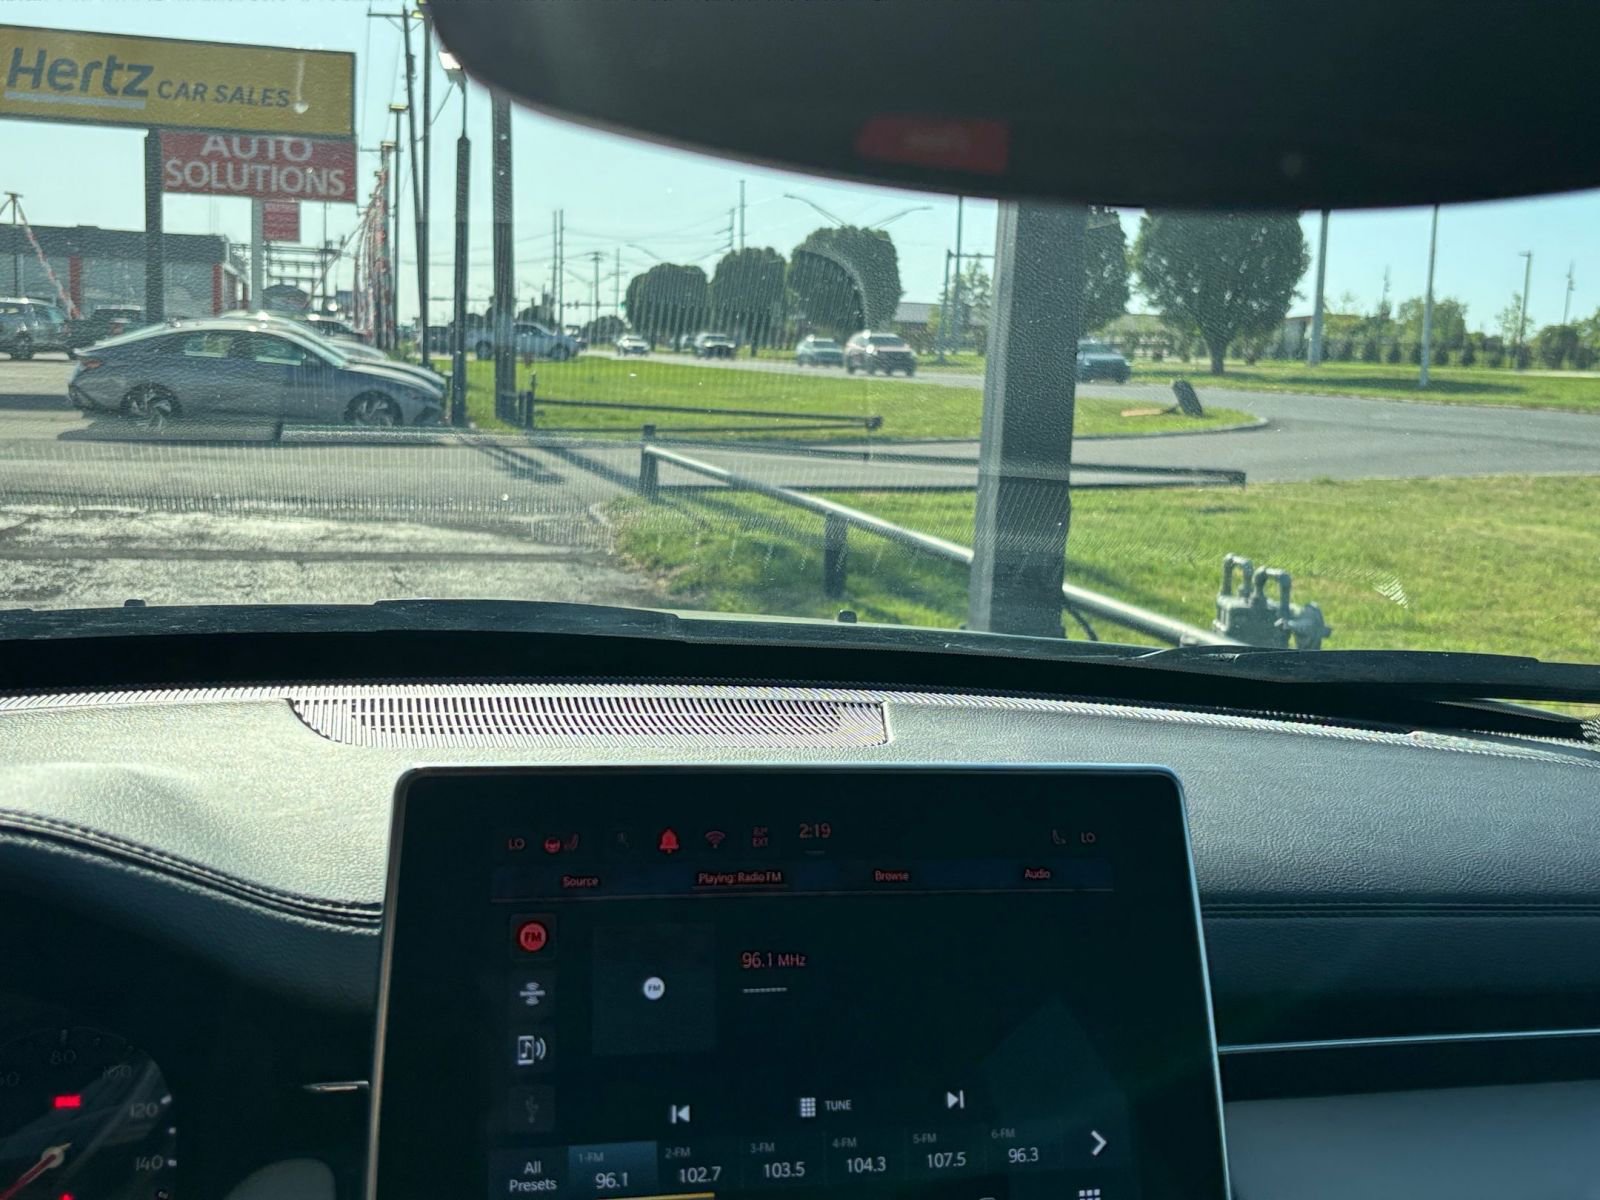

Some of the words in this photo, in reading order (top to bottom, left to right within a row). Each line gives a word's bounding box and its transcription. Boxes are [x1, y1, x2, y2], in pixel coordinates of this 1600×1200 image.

[6, 47, 154, 97] Hertz
[157, 80, 208, 101] CAR
[215, 84, 291, 108] SALES
[200, 135, 313, 161] AUTO
[164, 158, 346, 196] SOLUTIONS
[799, 823, 831, 839] 2:19
[1080, 832, 1096, 844] LO
[508, 838, 525, 850] LO
[874, 870, 910, 882] Browse
[1024, 868, 1051, 880] Audio
[562, 876, 599, 888] Source
[523, 931, 542, 944] FM
[741, 952, 773, 968] 96.1
[778, 954, 807, 968] MHz
[130, 1102, 158, 1118] 120
[825, 1099, 852, 1112] TUNE
[913, 1132, 937, 1144] 5-FM
[991, 1127, 1016, 1140] 6-FM
[750, 1142, 775, 1153] 3-FM
[832, 1137, 857, 1149] 4-FM
[578, 1152, 604, 1164] 1-FM
[665, 1147, 691, 1159] 2-FM
[1008, 1147, 1039, 1163] 96.3
[135, 1155, 164, 1171] 140
[846, 1156, 887, 1173] 104.3
[927, 1152, 966, 1169] 107.5
[524, 1161, 541, 1175] All
[679, 1166, 722, 1184] 102.7
[764, 1161, 806, 1178] 103.5
[509, 1178, 557, 1193] Presets
[595, 1172, 629, 1188] 96.1
